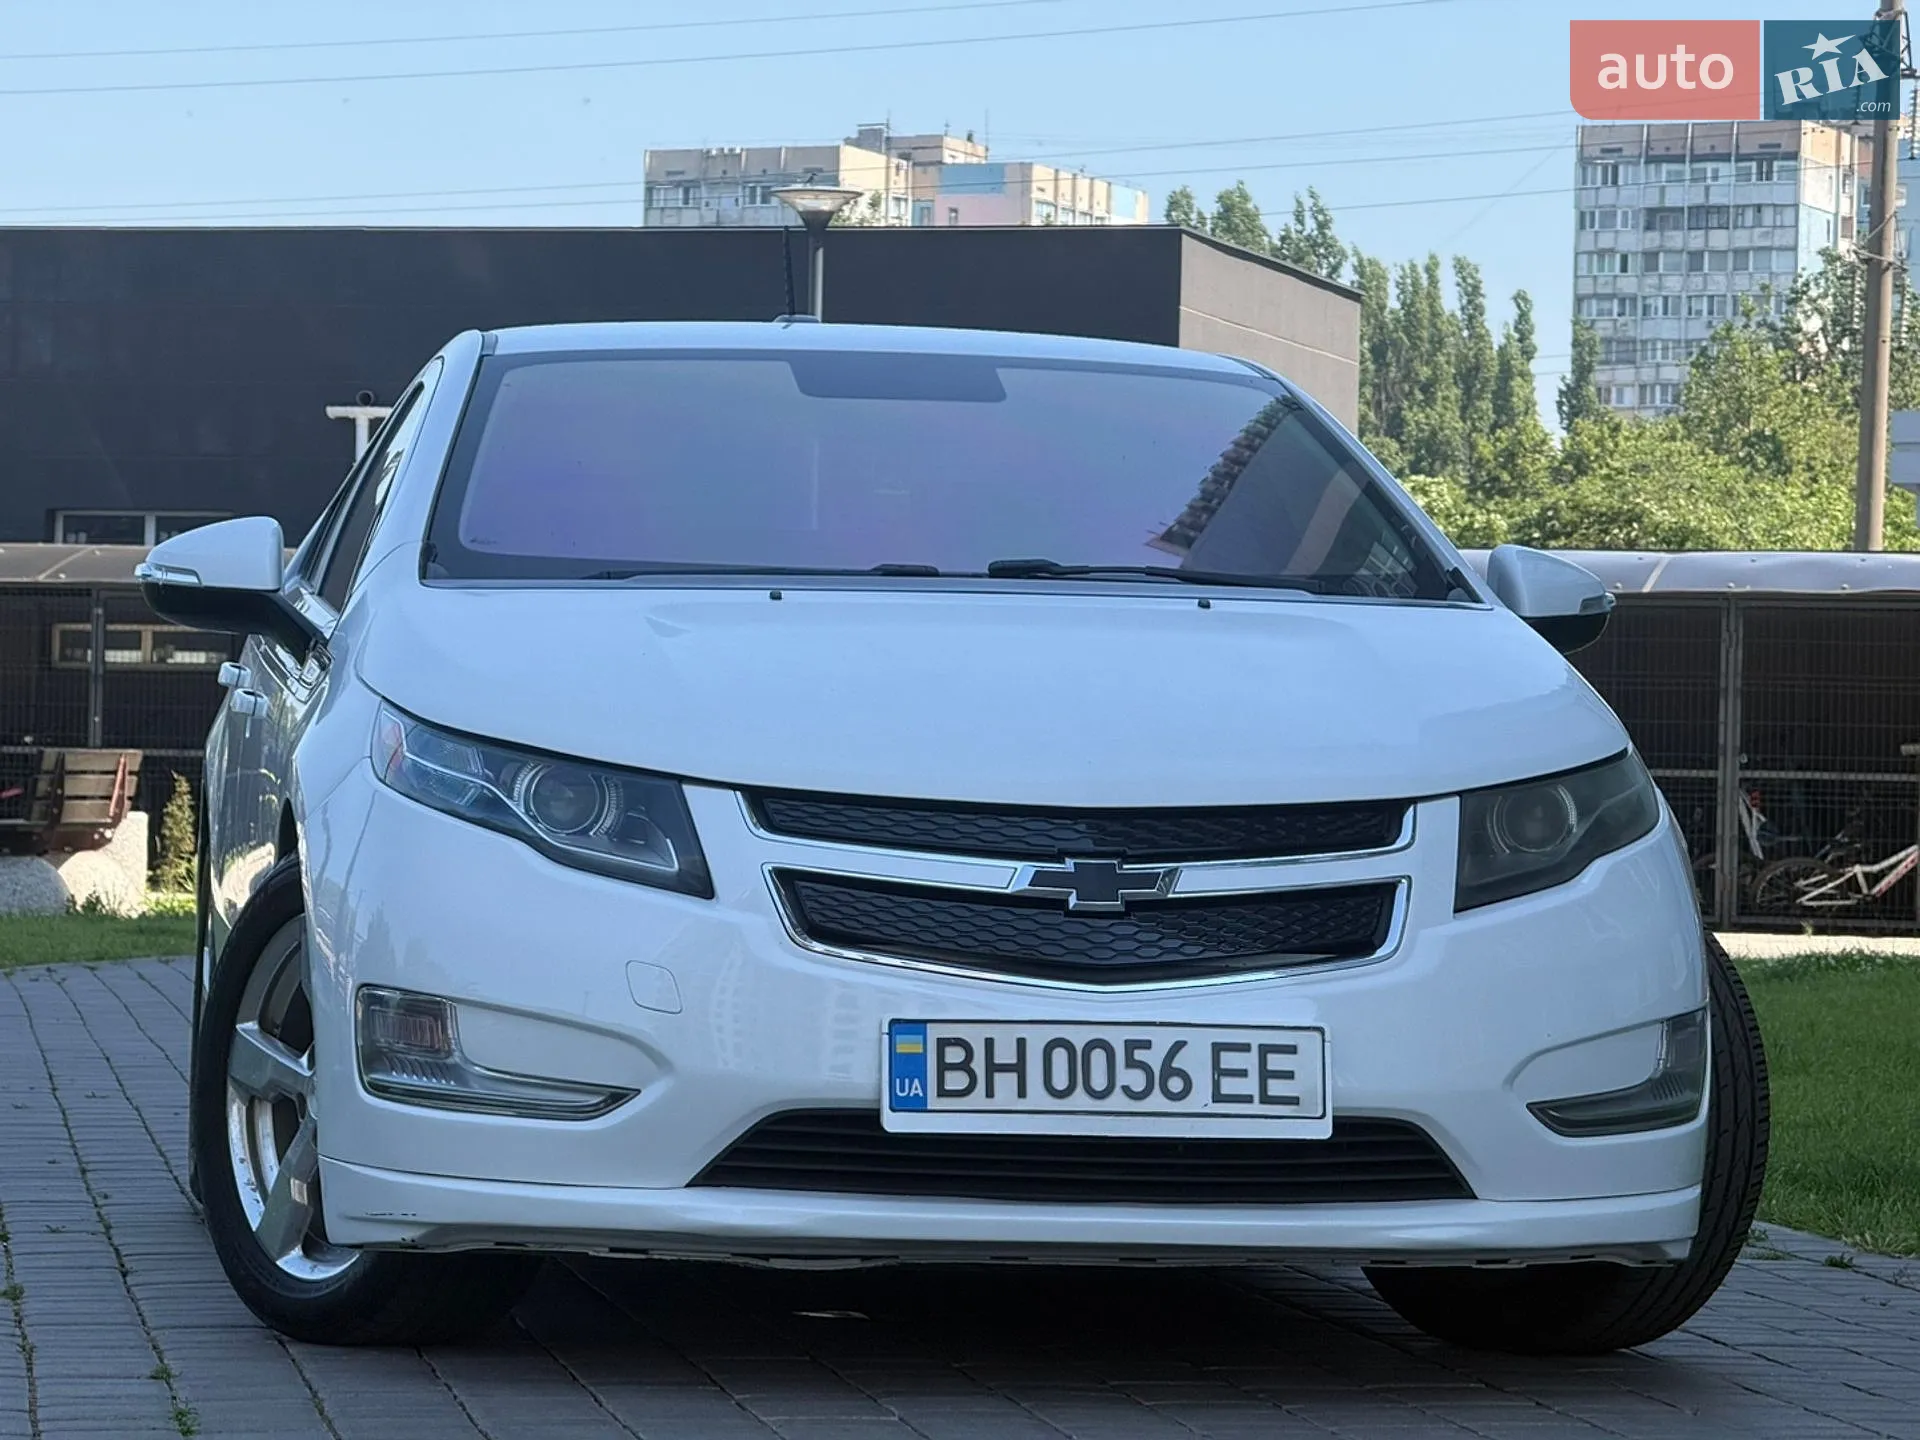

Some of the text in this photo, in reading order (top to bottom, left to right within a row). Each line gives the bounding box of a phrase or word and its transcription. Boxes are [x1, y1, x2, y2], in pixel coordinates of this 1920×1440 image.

[895, 1078, 924, 1097] UA
[935, 1037, 1300, 1105] BH 0056 EE
